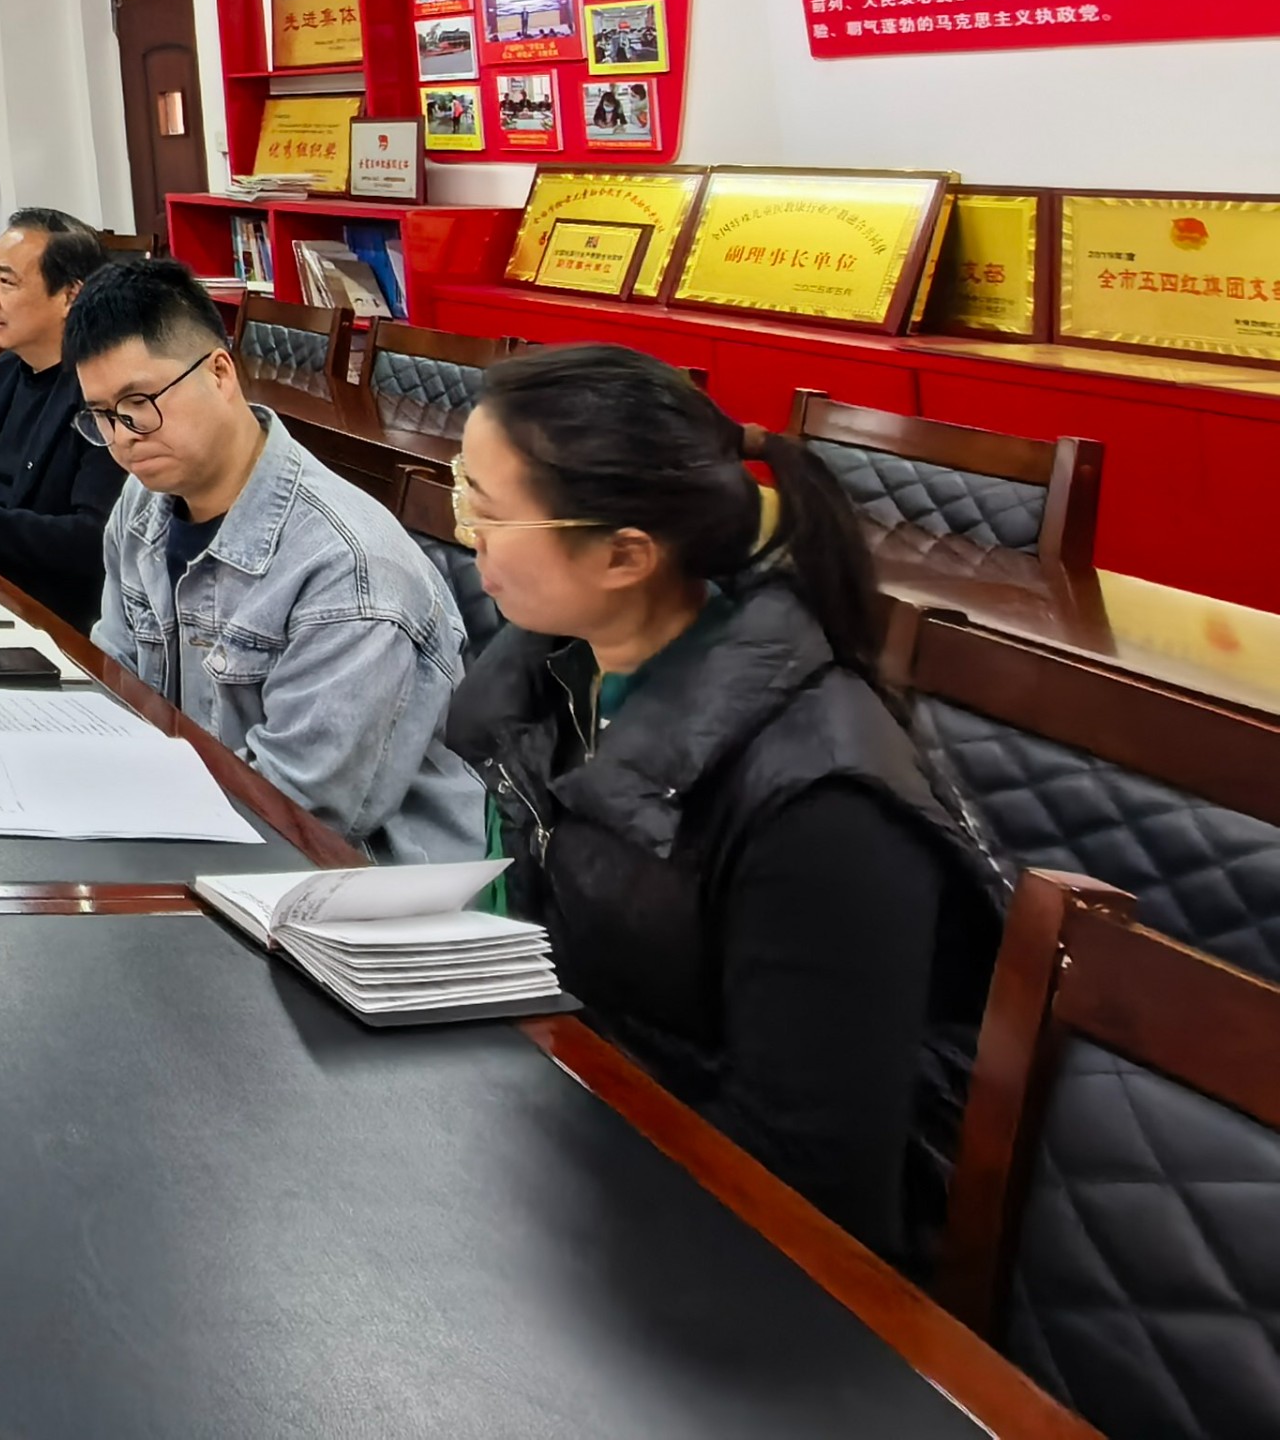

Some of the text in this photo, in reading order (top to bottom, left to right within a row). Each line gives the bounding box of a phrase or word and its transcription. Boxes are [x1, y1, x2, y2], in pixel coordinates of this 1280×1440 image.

[283, 5, 357, 32] 先进集体
[724, 244, 858, 273] 副理事长单位
